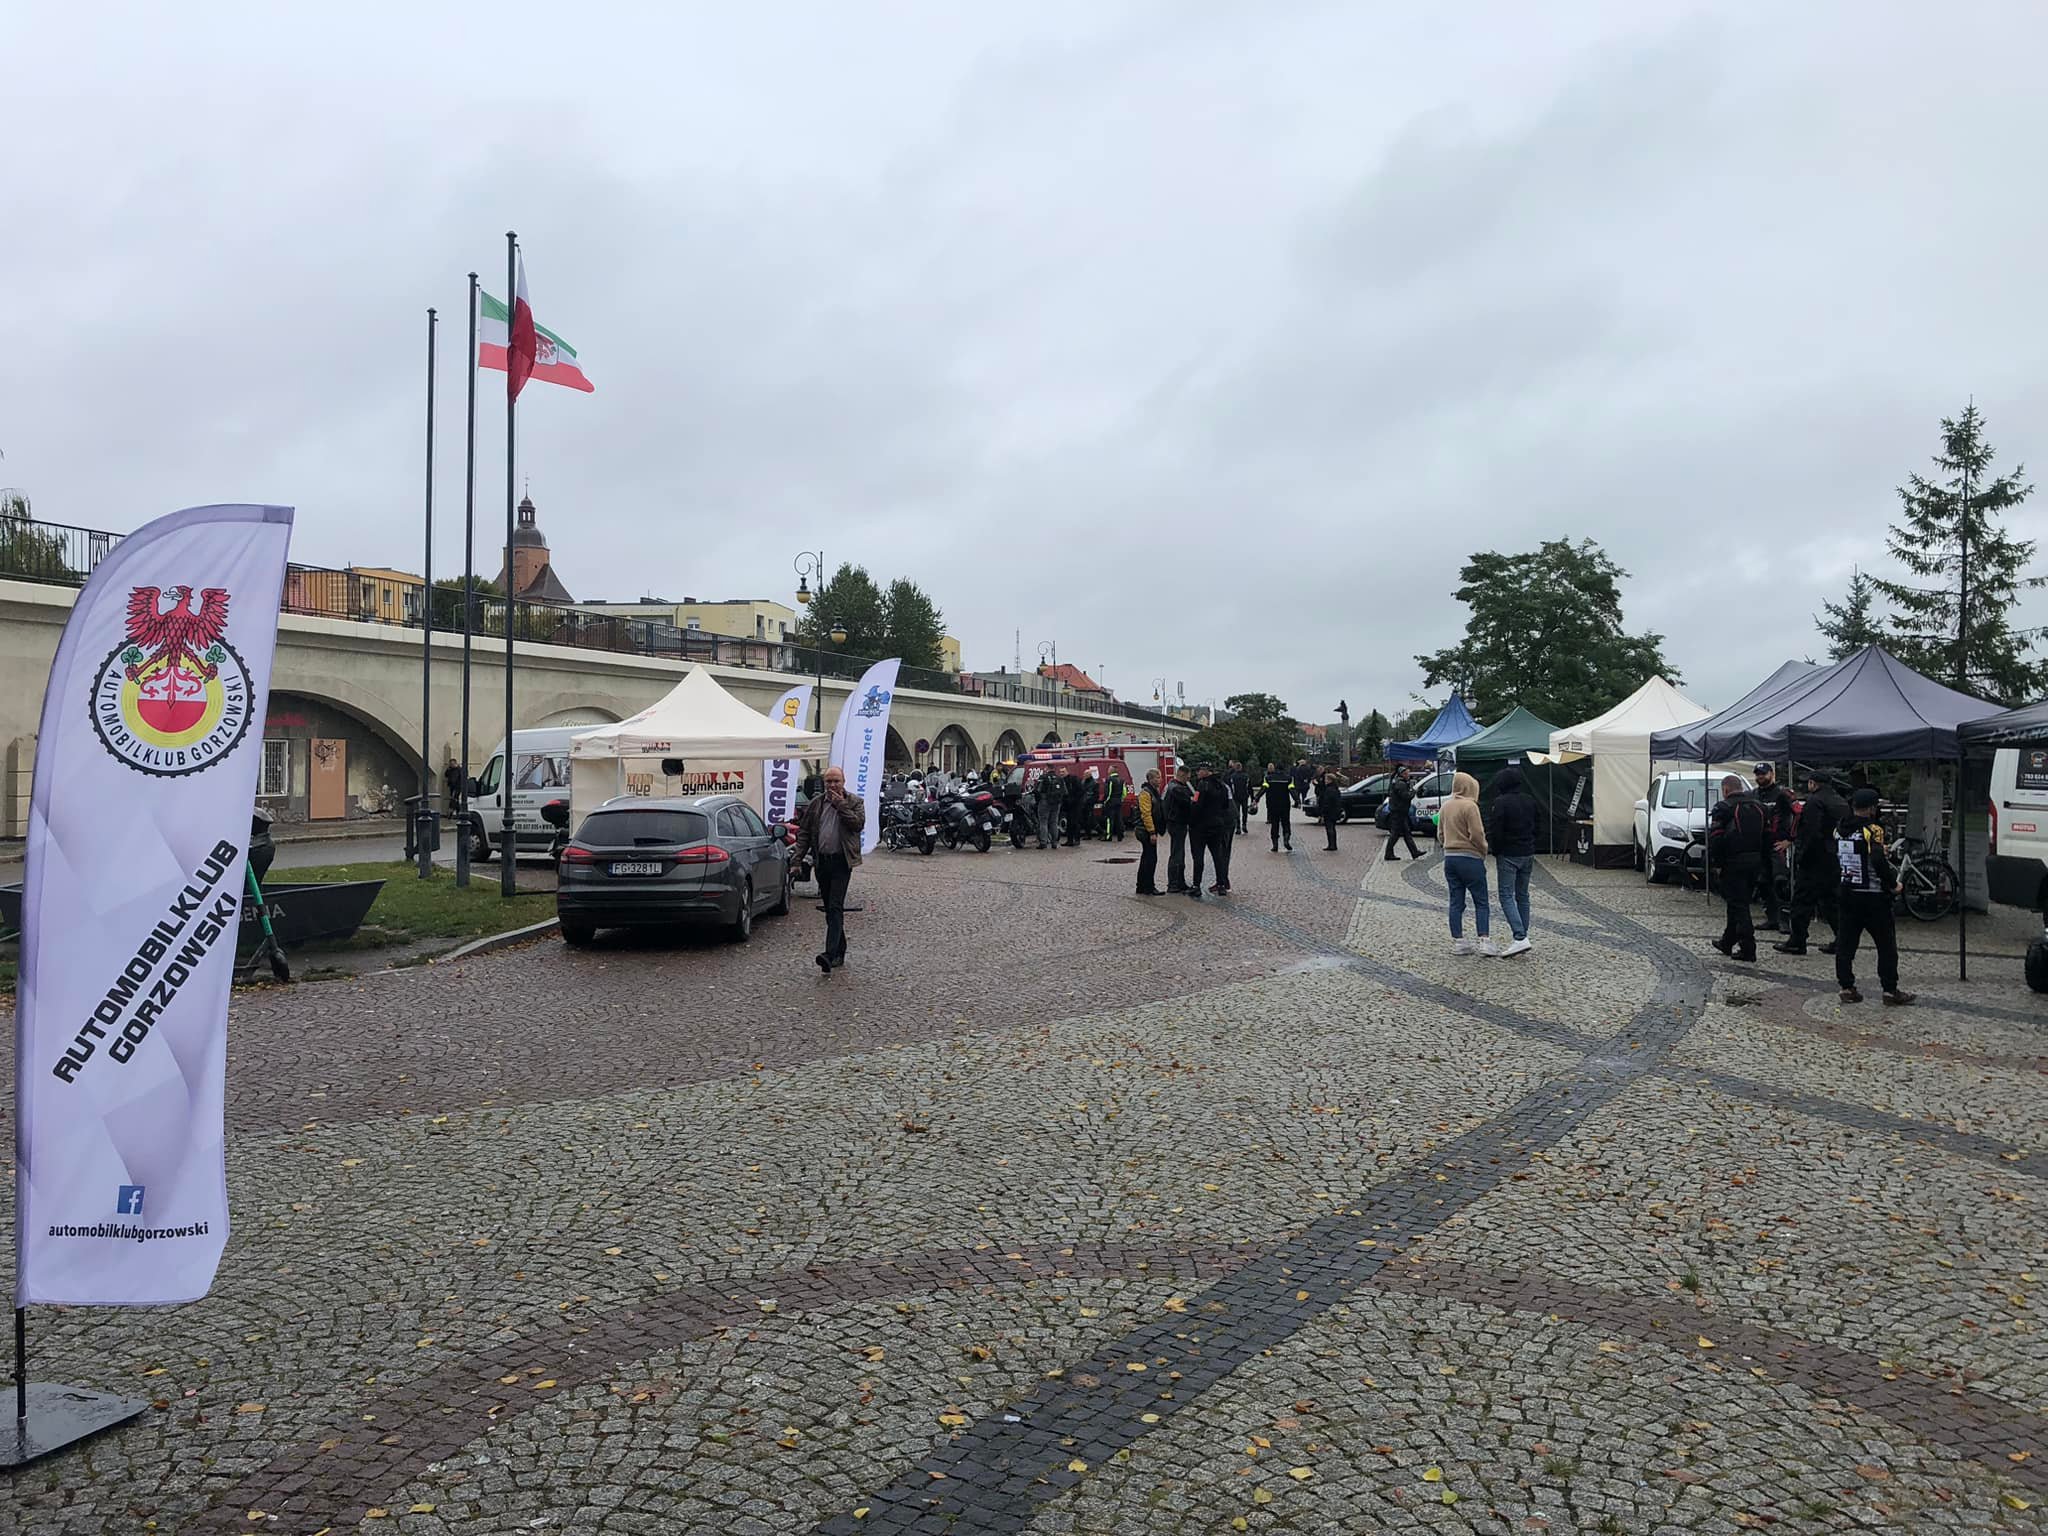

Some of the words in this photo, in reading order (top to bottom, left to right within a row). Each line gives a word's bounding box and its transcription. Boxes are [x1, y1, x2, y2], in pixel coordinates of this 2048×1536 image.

[100, 670, 186, 766] AUTOMOBILKLUB
[191, 675, 243, 760] GORZOWSKI
[682, 780, 744, 795] gymkhana
[614, 863, 627, 873] FG
[630, 863, 660, 873] 3281L
[52, 839, 239, 1083] AUTOMOBILKLUB
[108, 892, 238, 1064] GORZOWSKI
[49, 1222, 209, 1243] automobilklubgorzowski
